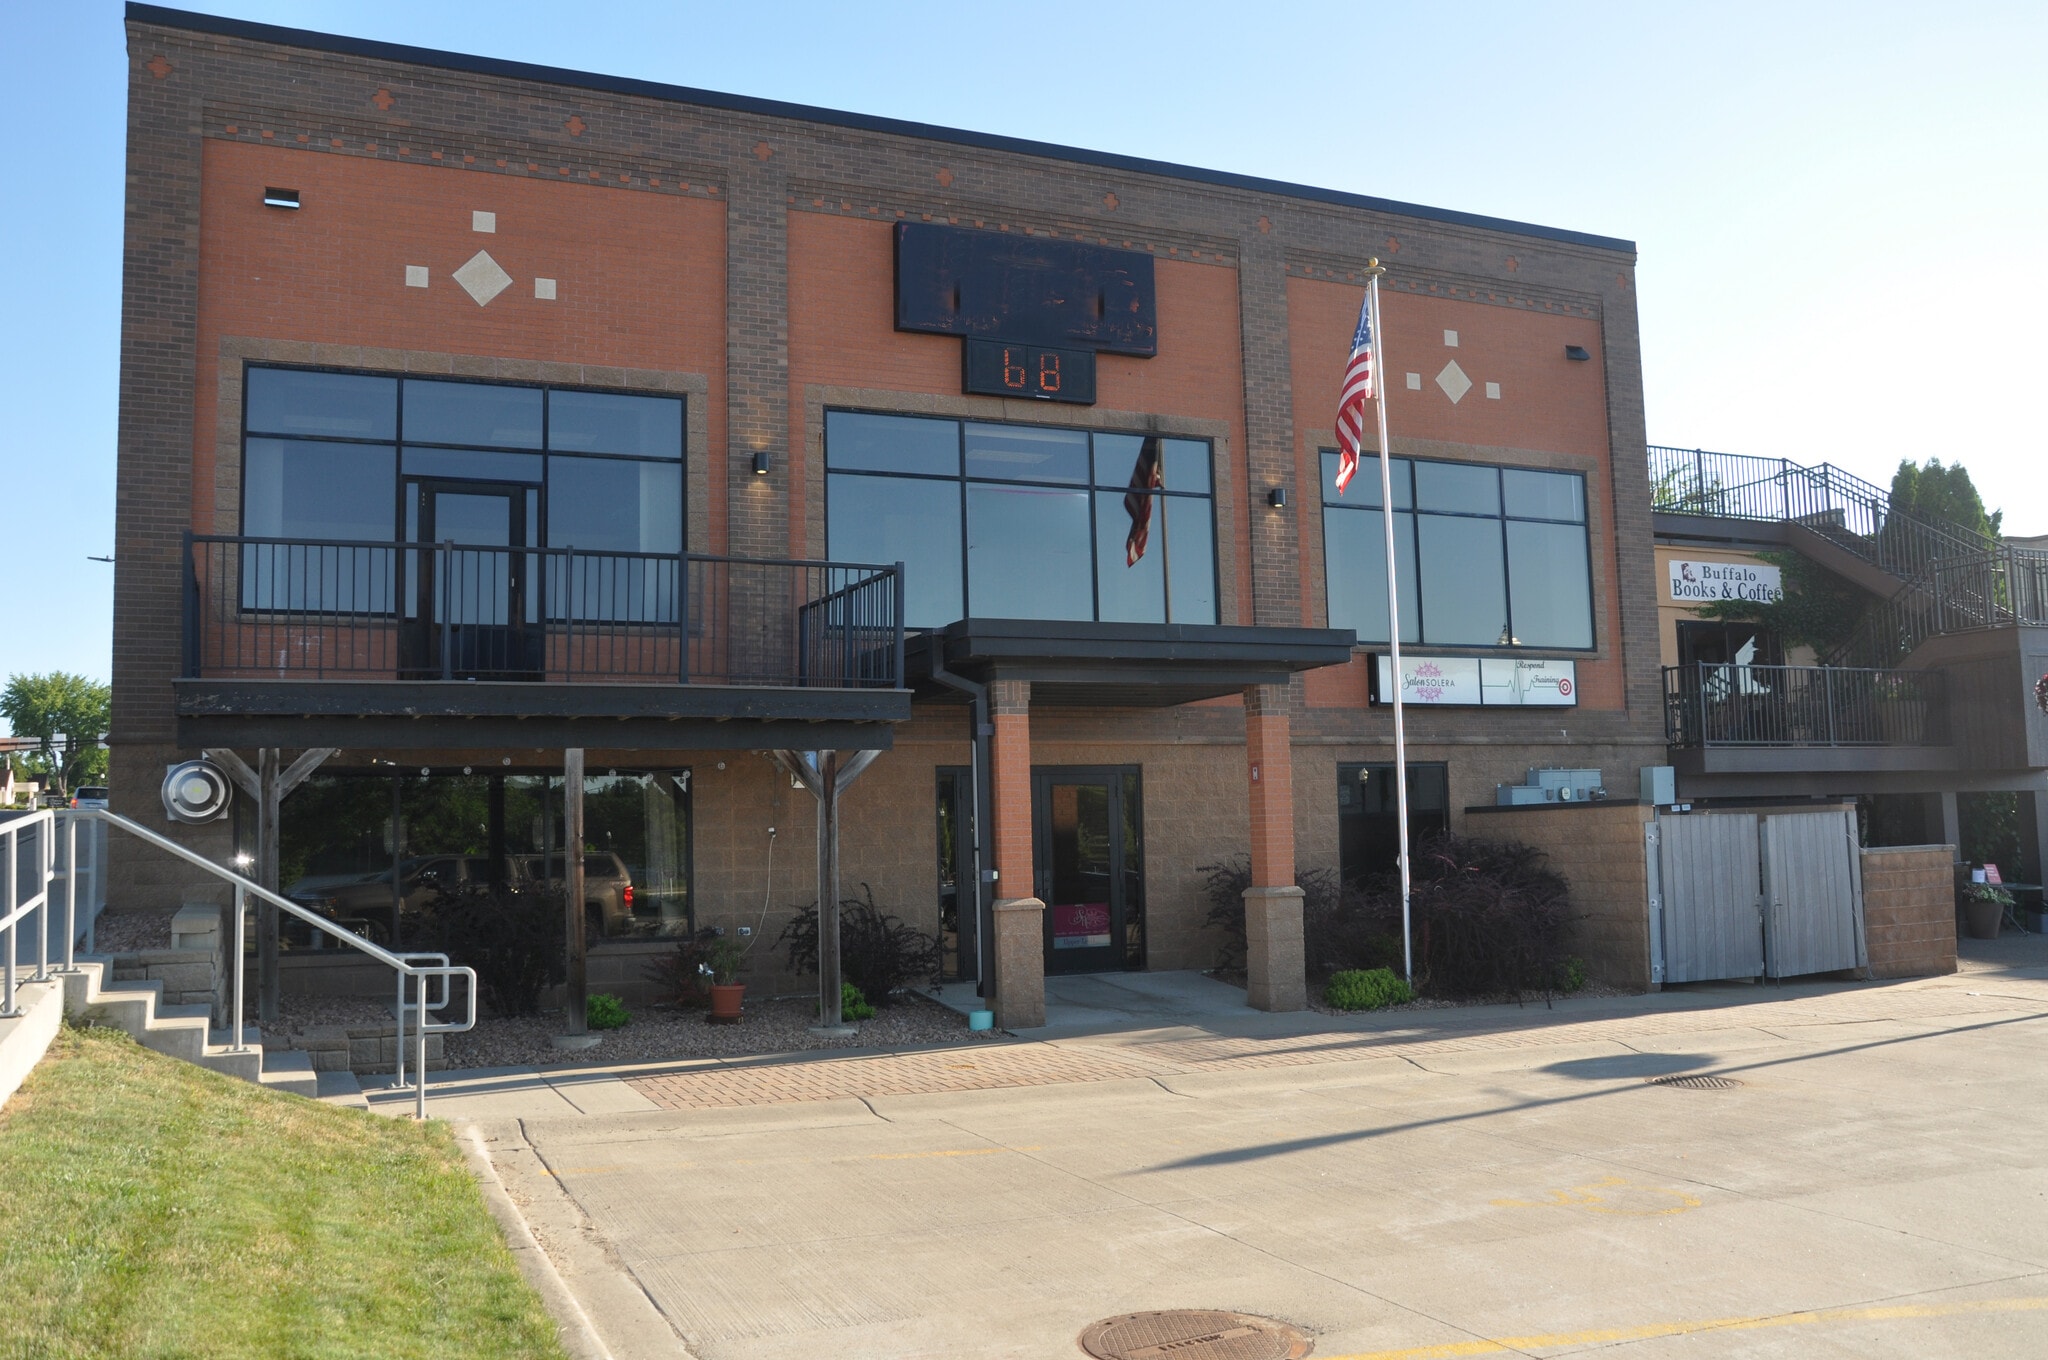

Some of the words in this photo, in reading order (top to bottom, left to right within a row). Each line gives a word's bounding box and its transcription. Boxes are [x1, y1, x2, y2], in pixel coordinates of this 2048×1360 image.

[1004, 347, 1061, 392] 68
[1702, 565, 1756, 581] Buffalo
[1672, 579, 1716, 598] Books
[1721, 581, 1733, 599] &
[1737, 582, 1781, 601] Coffee
[1517, 660, 1545, 671] Respond
[1425, 679, 1455, 688] SOLERA
[1533, 674, 1559, 685] Training
